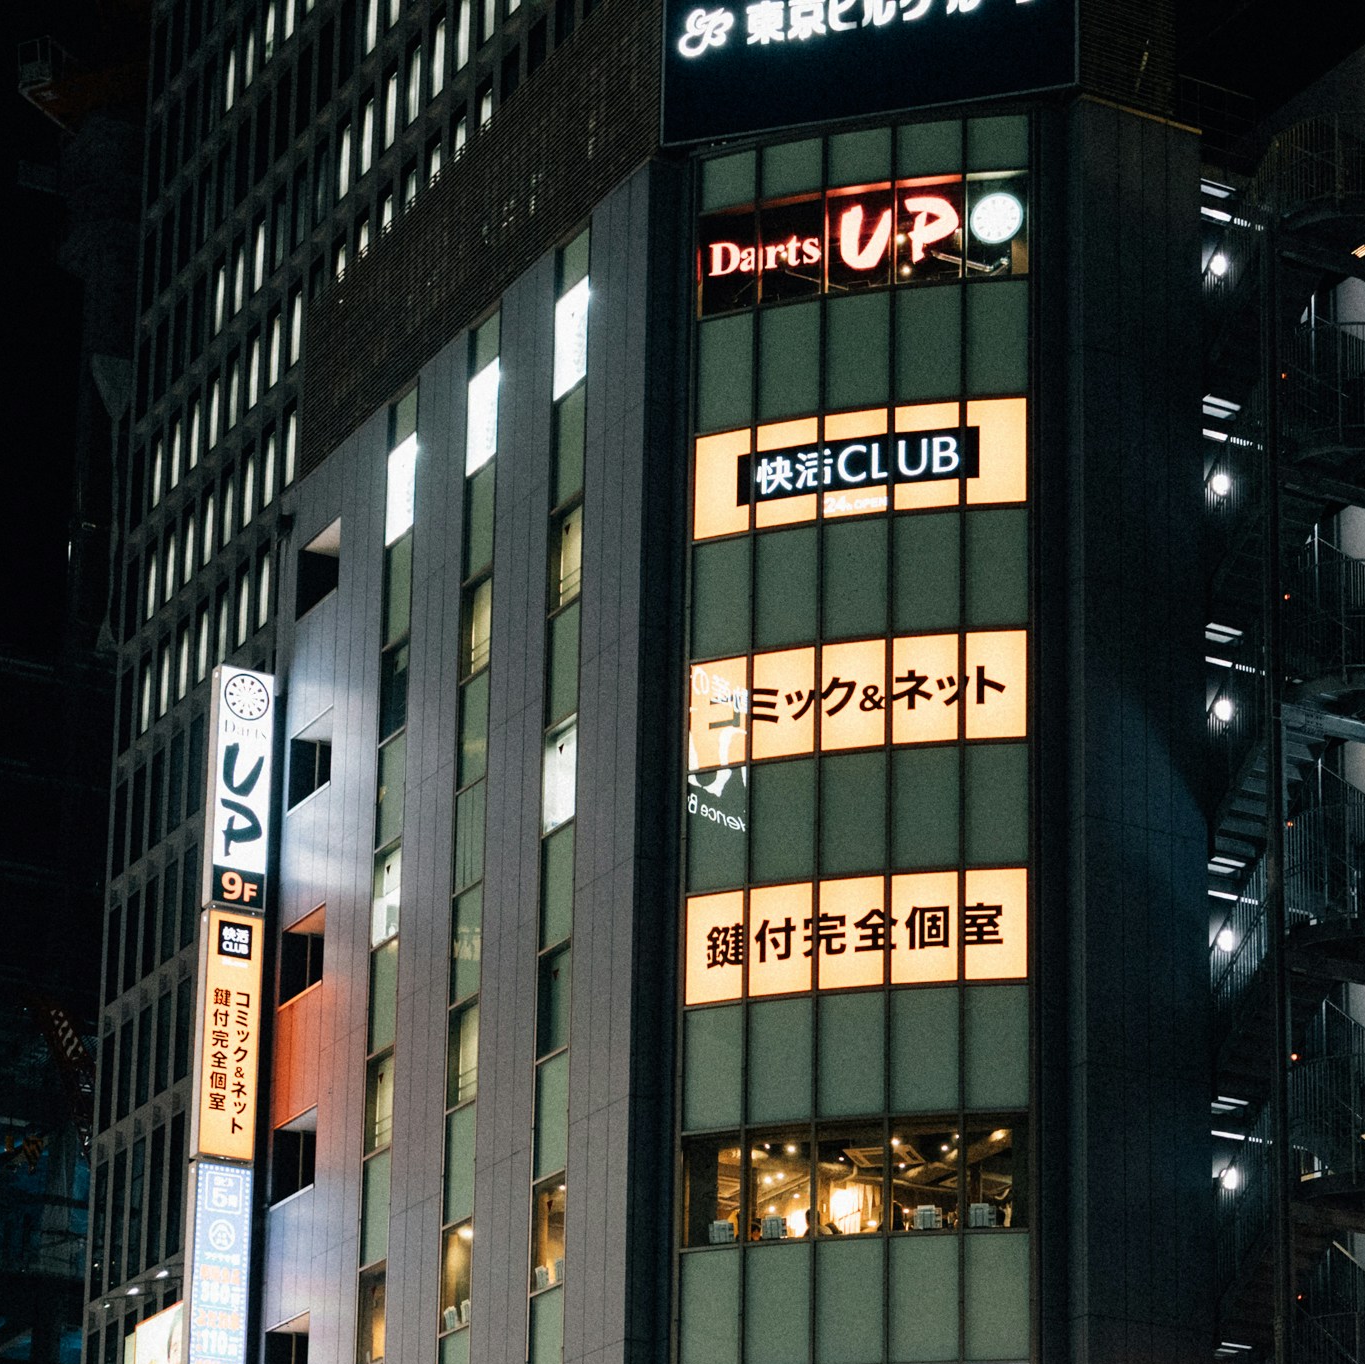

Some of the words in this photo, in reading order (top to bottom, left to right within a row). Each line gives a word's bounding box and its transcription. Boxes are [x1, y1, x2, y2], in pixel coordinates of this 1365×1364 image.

[709, 235, 822, 277] Darts
[839, 196, 960, 271] UP
[755, 435, 960, 495] 快活CLUB
[709, 665, 1007, 730] コミック&ネット
[219, 742, 266, 858] UP
[221, 871, 259, 903] 9F
[706, 902, 1004, 969] 鍵付完全個室
[208, 987, 232, 1111] 鍵付完全個室
[230, 991, 255, 1135] コミック&ネット
